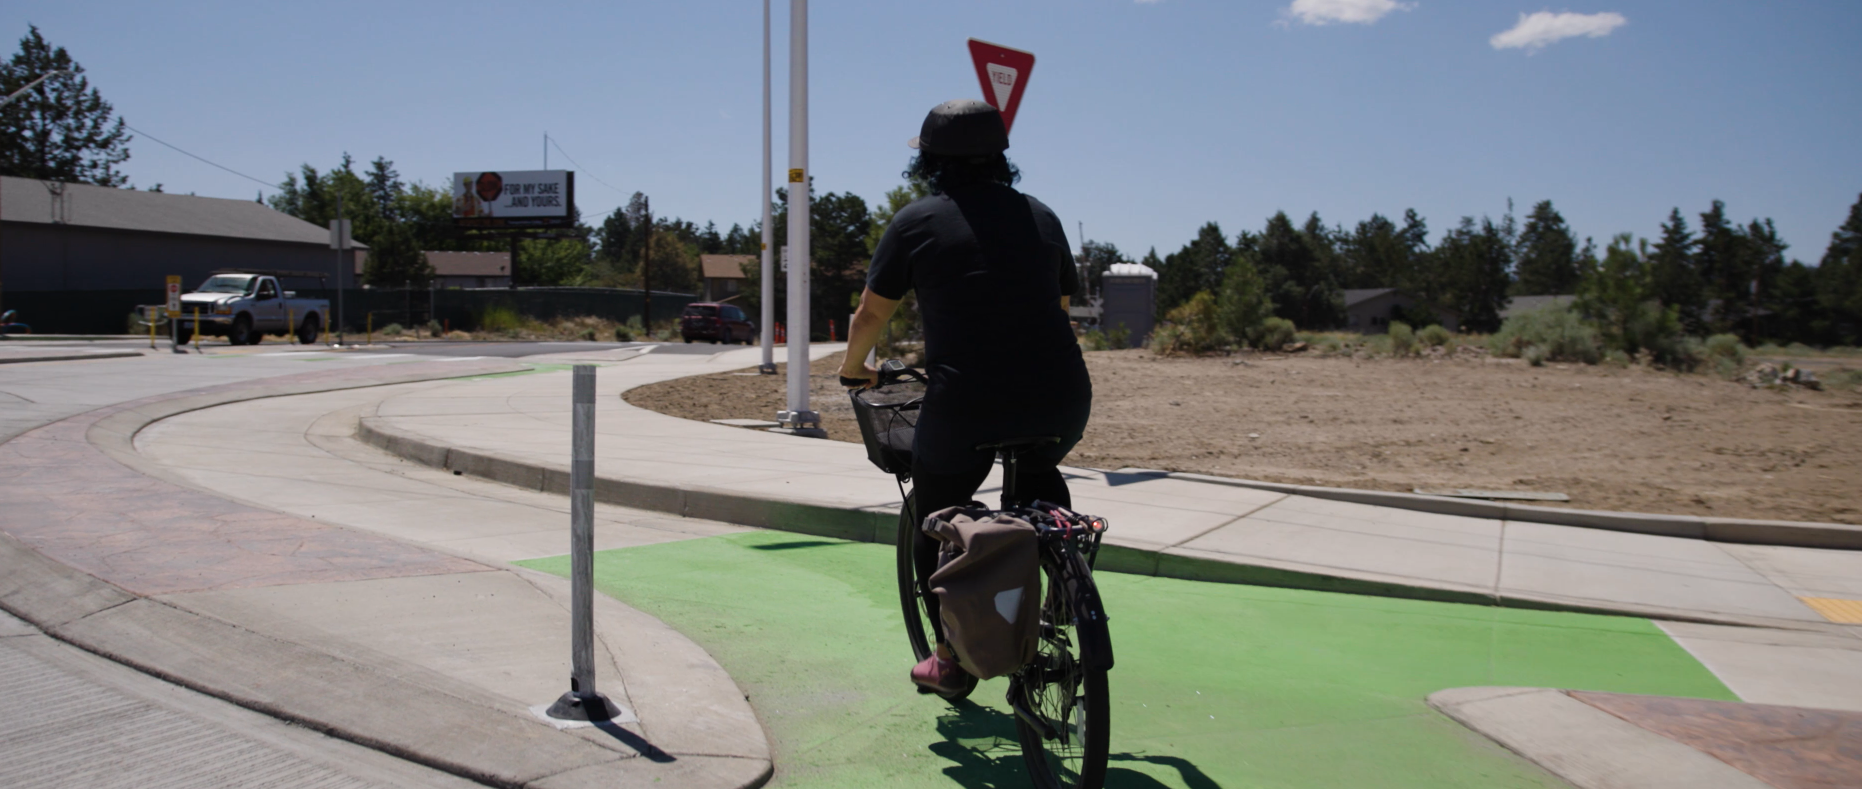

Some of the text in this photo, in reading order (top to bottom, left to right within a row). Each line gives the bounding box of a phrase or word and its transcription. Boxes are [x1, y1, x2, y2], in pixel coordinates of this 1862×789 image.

[992, 71, 1012, 86] YIELD
[504, 183, 521, 195] FOR
[523, 183, 536, 194] MY
[538, 182, 559, 194] SAKE
[531, 195, 562, 207] YOURS.
